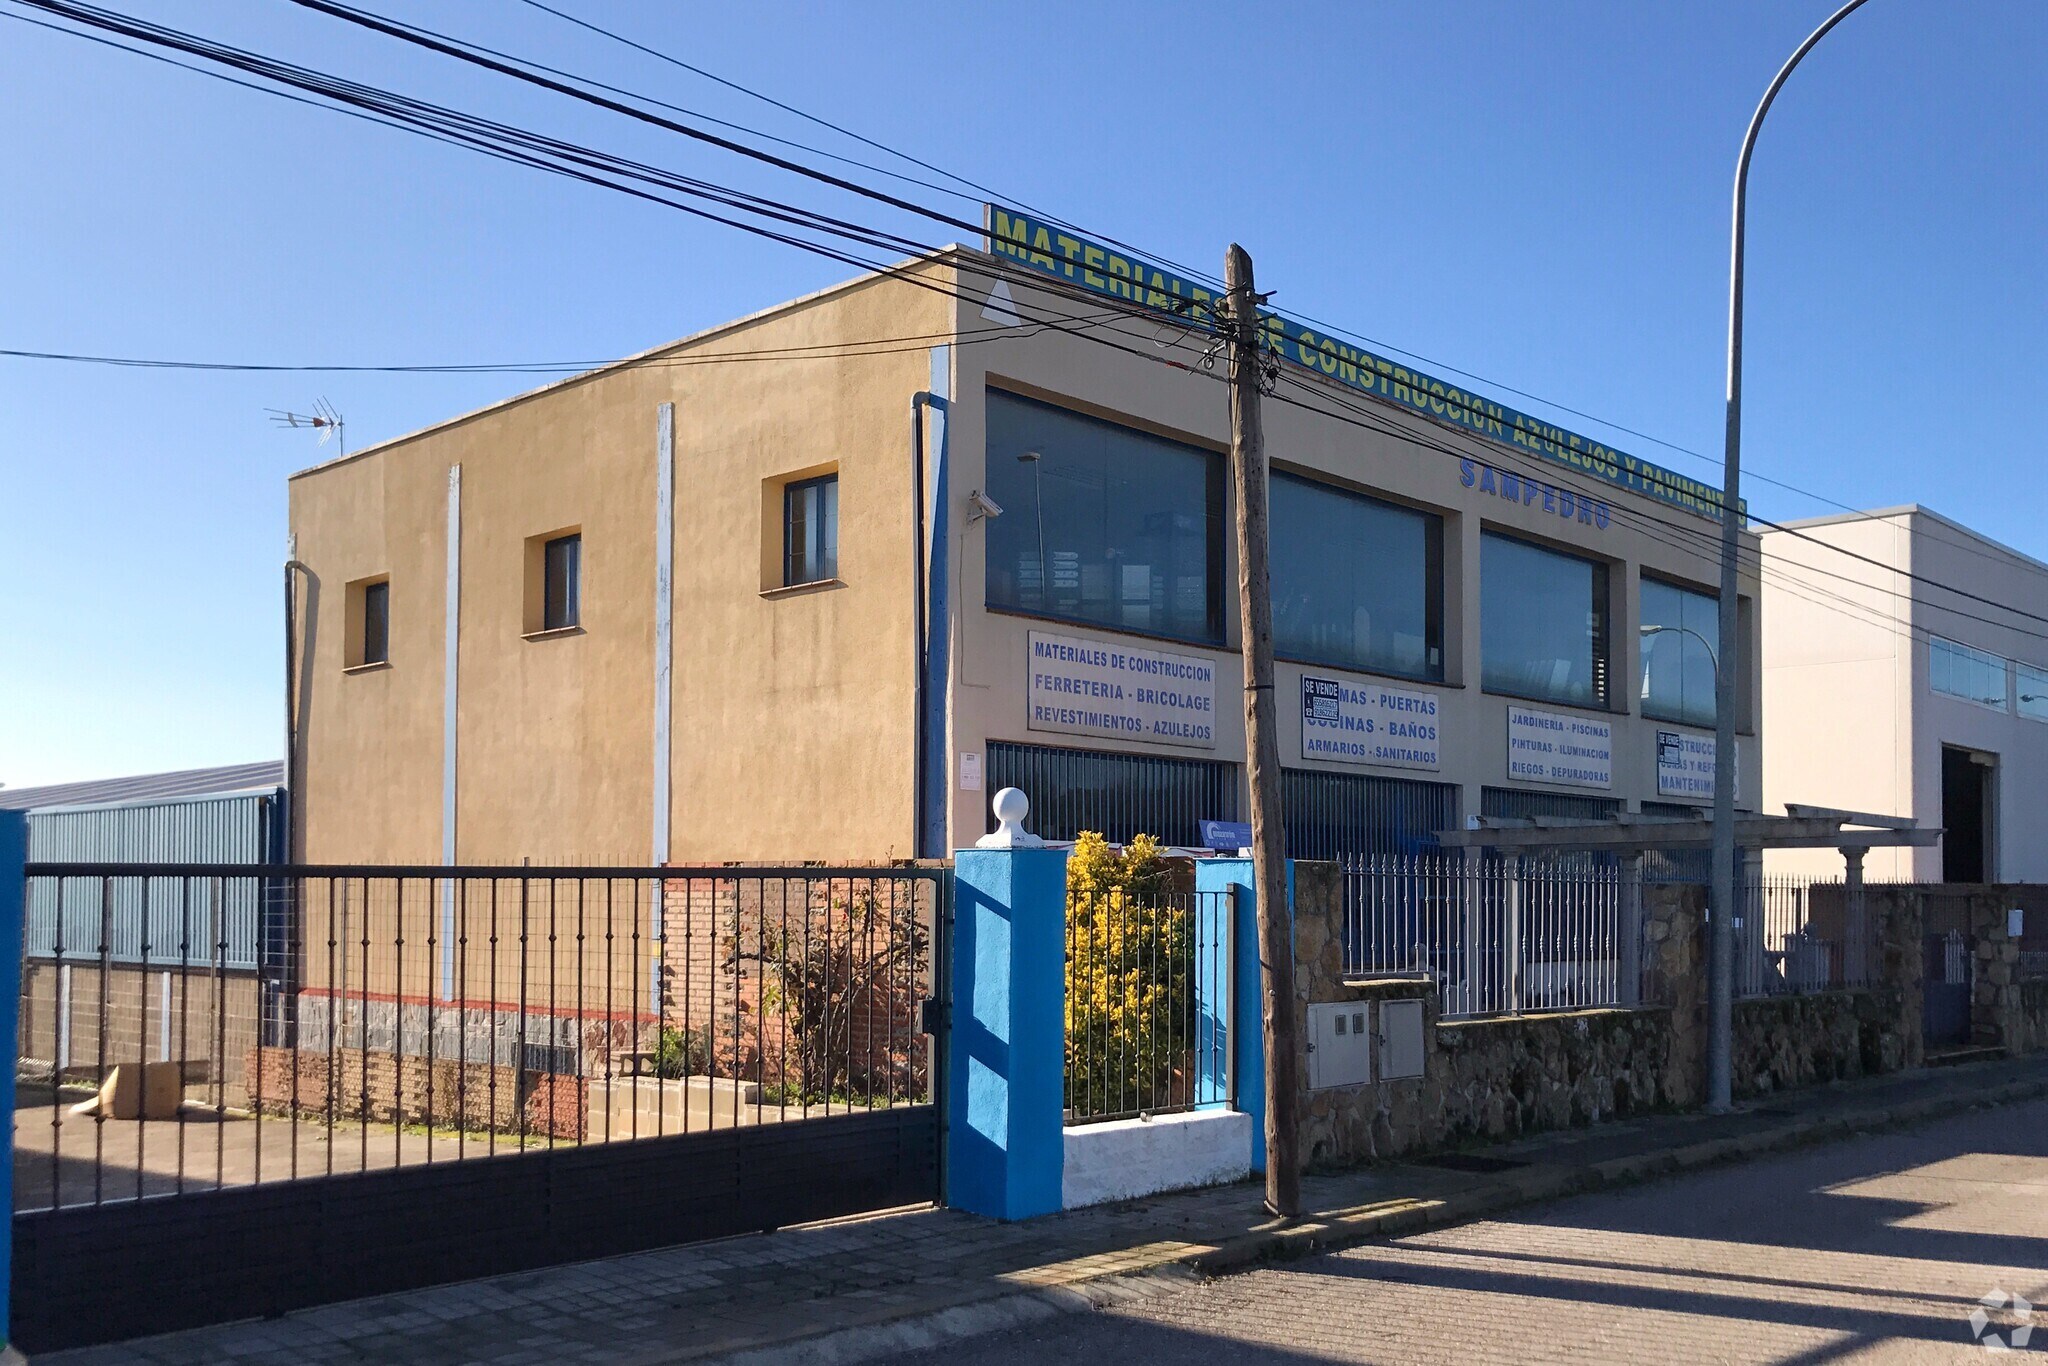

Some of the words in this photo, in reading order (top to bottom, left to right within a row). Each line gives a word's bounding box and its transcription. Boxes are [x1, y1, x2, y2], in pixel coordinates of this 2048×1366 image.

[1298, 331, 1503, 436] CONSTRUCCION
[1513, 414, 1618, 478] AZULEJOS
[1624, 457, 1638, 485] Y
[1642, 466, 1747, 527] PAVIMENTS
[1459, 456, 1610, 530] SAMPEDRO
[1035, 641, 1107, 667] MATERIALES
[1111, 654, 1126, 670] DE
[1129, 657, 1211, 682] CONSTRUCCION
[1035, 673, 1124, 700] FERRETERIA
[1137, 688, 1211, 712] BRICOLAGE
[1305, 680, 1314, 694] SE
[1315, 681, 1338, 697] VENDE
[1380, 693, 1436, 716] PUERTAS
[1035, 705, 1142, 732] REVESTIMIENTOS
[1153, 720, 1211, 740] AZULEJOS
[1390, 721, 1436, 741] BAÑOS
[1512, 714, 1563, 732] JARDINERIA
[1572, 722, 1609, 738] PISCINAS
[1308, 738, 1366, 756] ARMARIOS
[1376, 746, 1436, 764] SANITARIOS
[1512, 738, 1552, 754] PINTURAS
[1559, 744, 1609, 760] ILUMINACION
[1512, 761, 1544, 776] RIEGOS
[1552, 766, 1609, 783] DEPURADORAS
